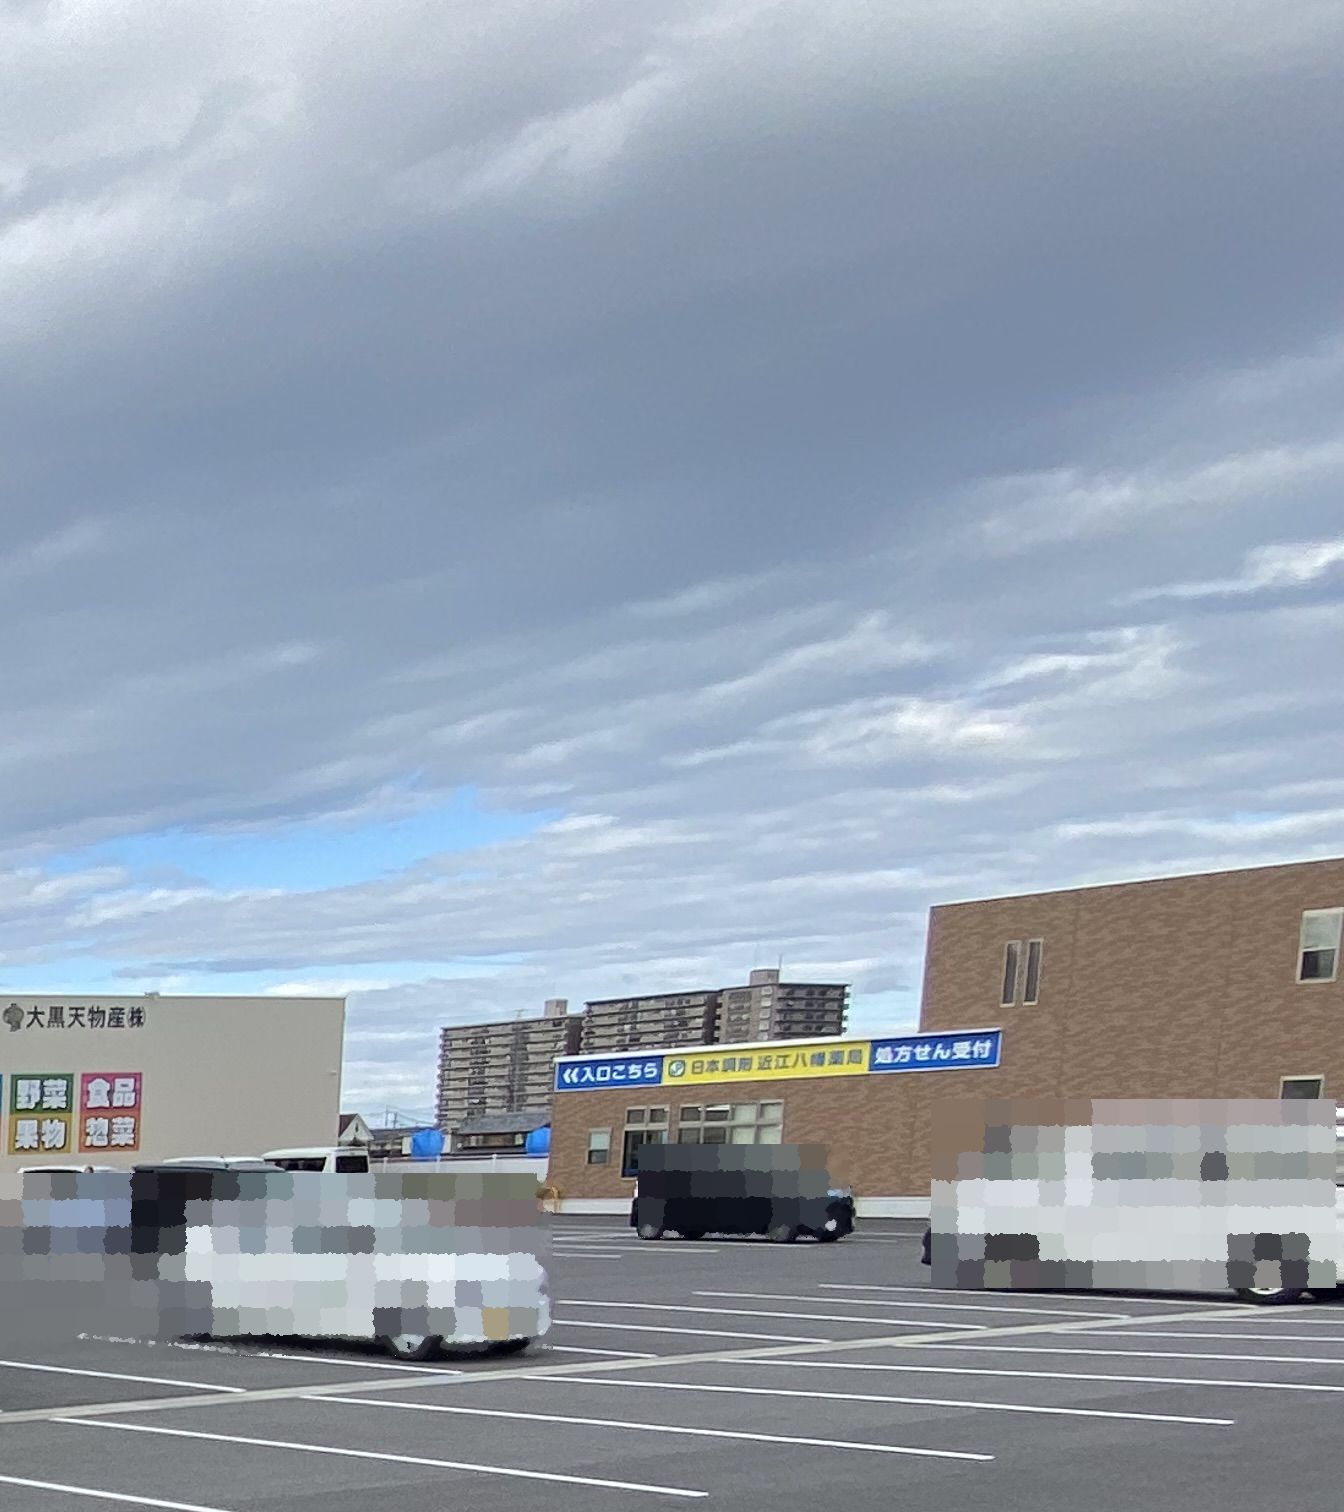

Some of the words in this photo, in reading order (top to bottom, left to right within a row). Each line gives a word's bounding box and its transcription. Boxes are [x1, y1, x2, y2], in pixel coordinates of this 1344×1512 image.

[874, 1041, 993, 1065] 処方せん受付
[579, 1061, 658, 1084] 入口こちら
[16, 1078, 68, 1110] 野菜
[86, 1077, 136, 1109] 食品
[15, 1118, 67, 1150] 果物
[85, 1116, 136, 1148] 惣菜
